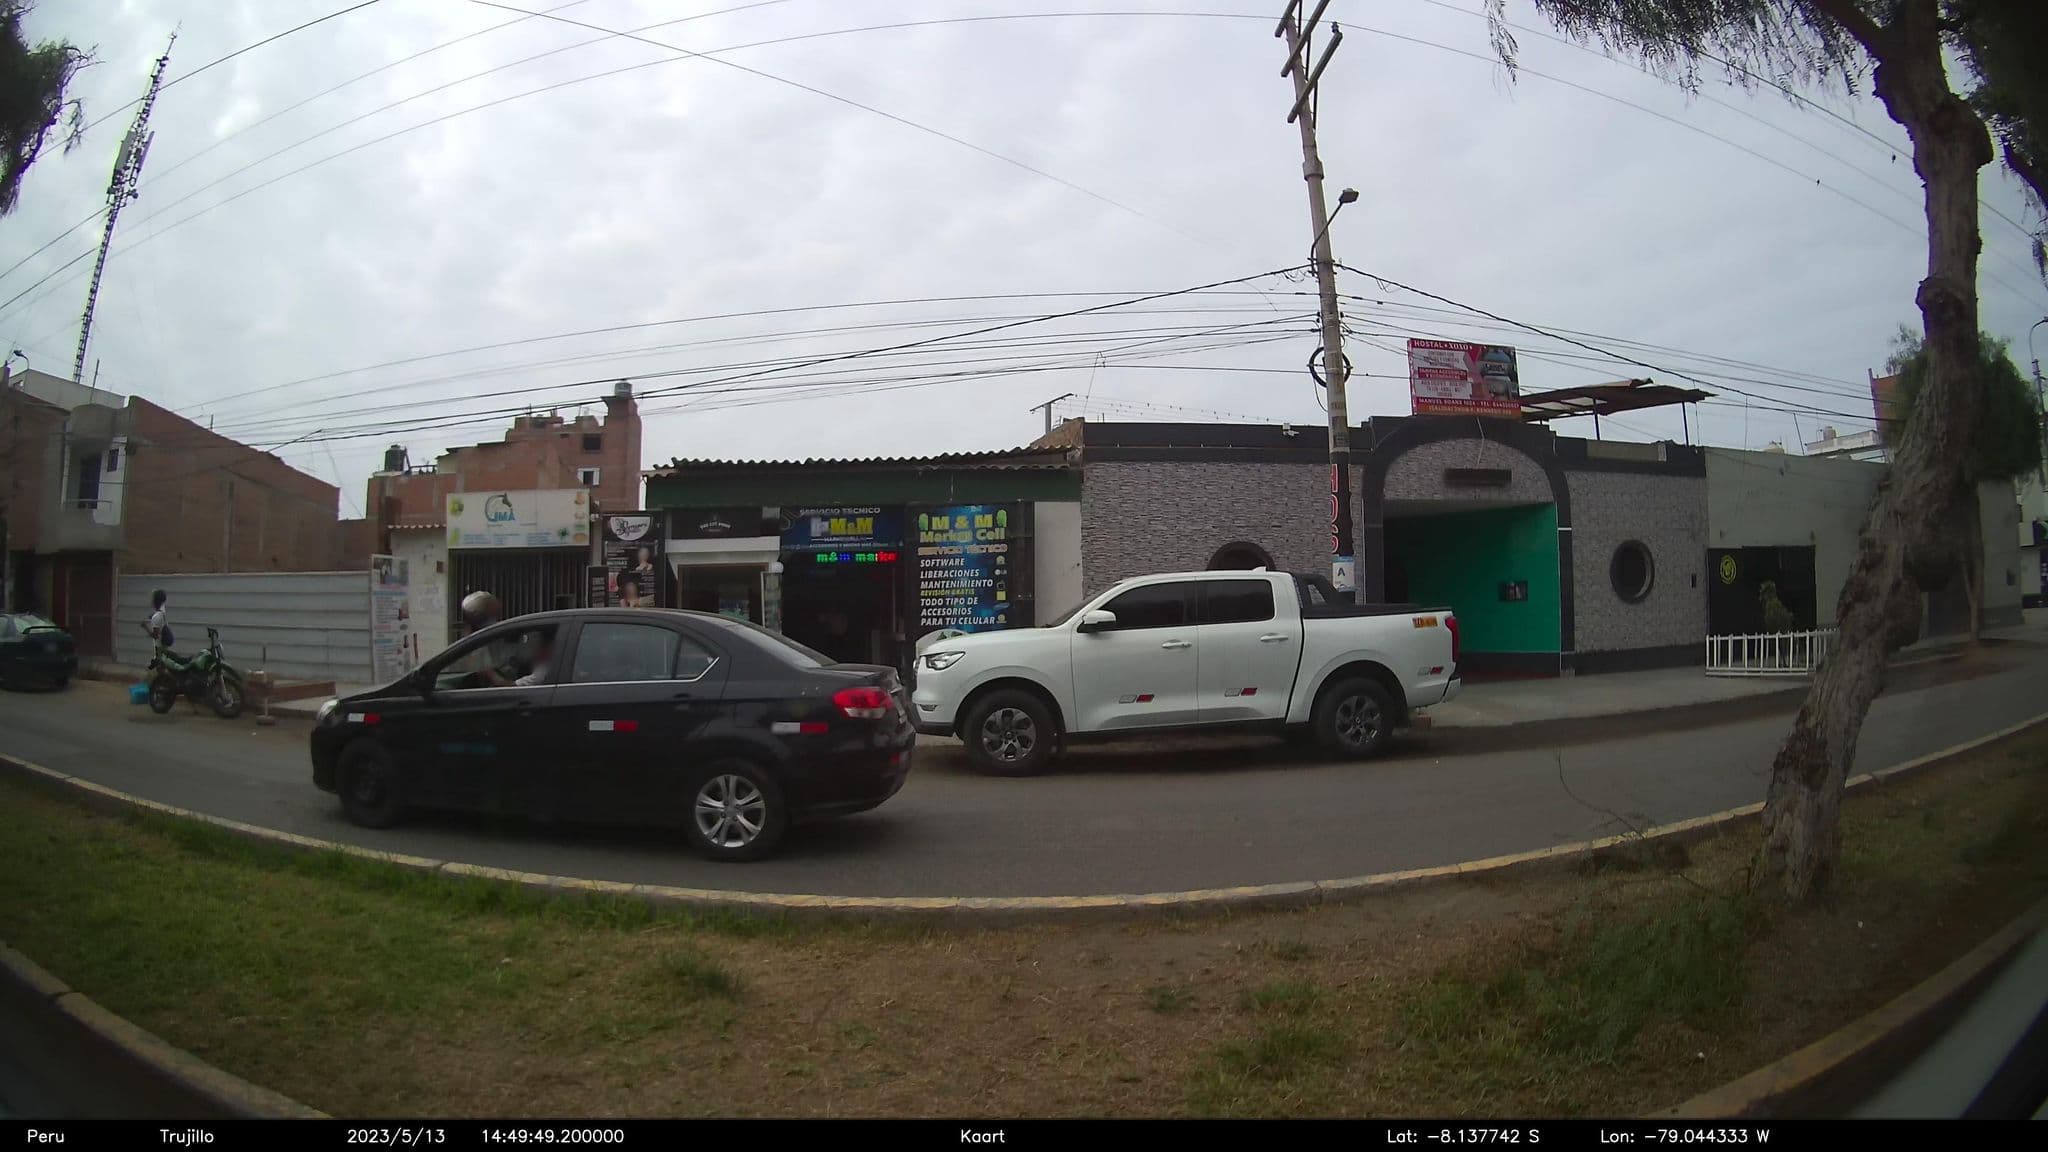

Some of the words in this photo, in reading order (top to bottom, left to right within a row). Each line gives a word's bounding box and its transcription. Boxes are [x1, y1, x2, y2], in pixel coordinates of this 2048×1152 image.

[1414, 340, 1444, 349] HOSTAL
[1448, 342, 1468, 351] XOXO
[931, 515, 950, 530] M
[955, 515, 969, 529] &
[974, 513, 993, 528] M
[976, 528, 1006, 540] Cell
[920, 558, 965, 568] SOFTWARE
[920, 568, 980, 579] LIBERACIONES
[1337, 567, 1346, 577] A
[920, 579, 994, 590] MANTENIMIENTO
[920, 598, 944, 607] TODO
[945, 597, 965, 606] TIPO
[967, 597, 979, 605] DE
[920, 607, 972, 617] ACCESORIOS
[920, 617, 943, 626] PARA
[945, 617, 958, 625] TU
[958, 616, 995, 625] CELULAR
